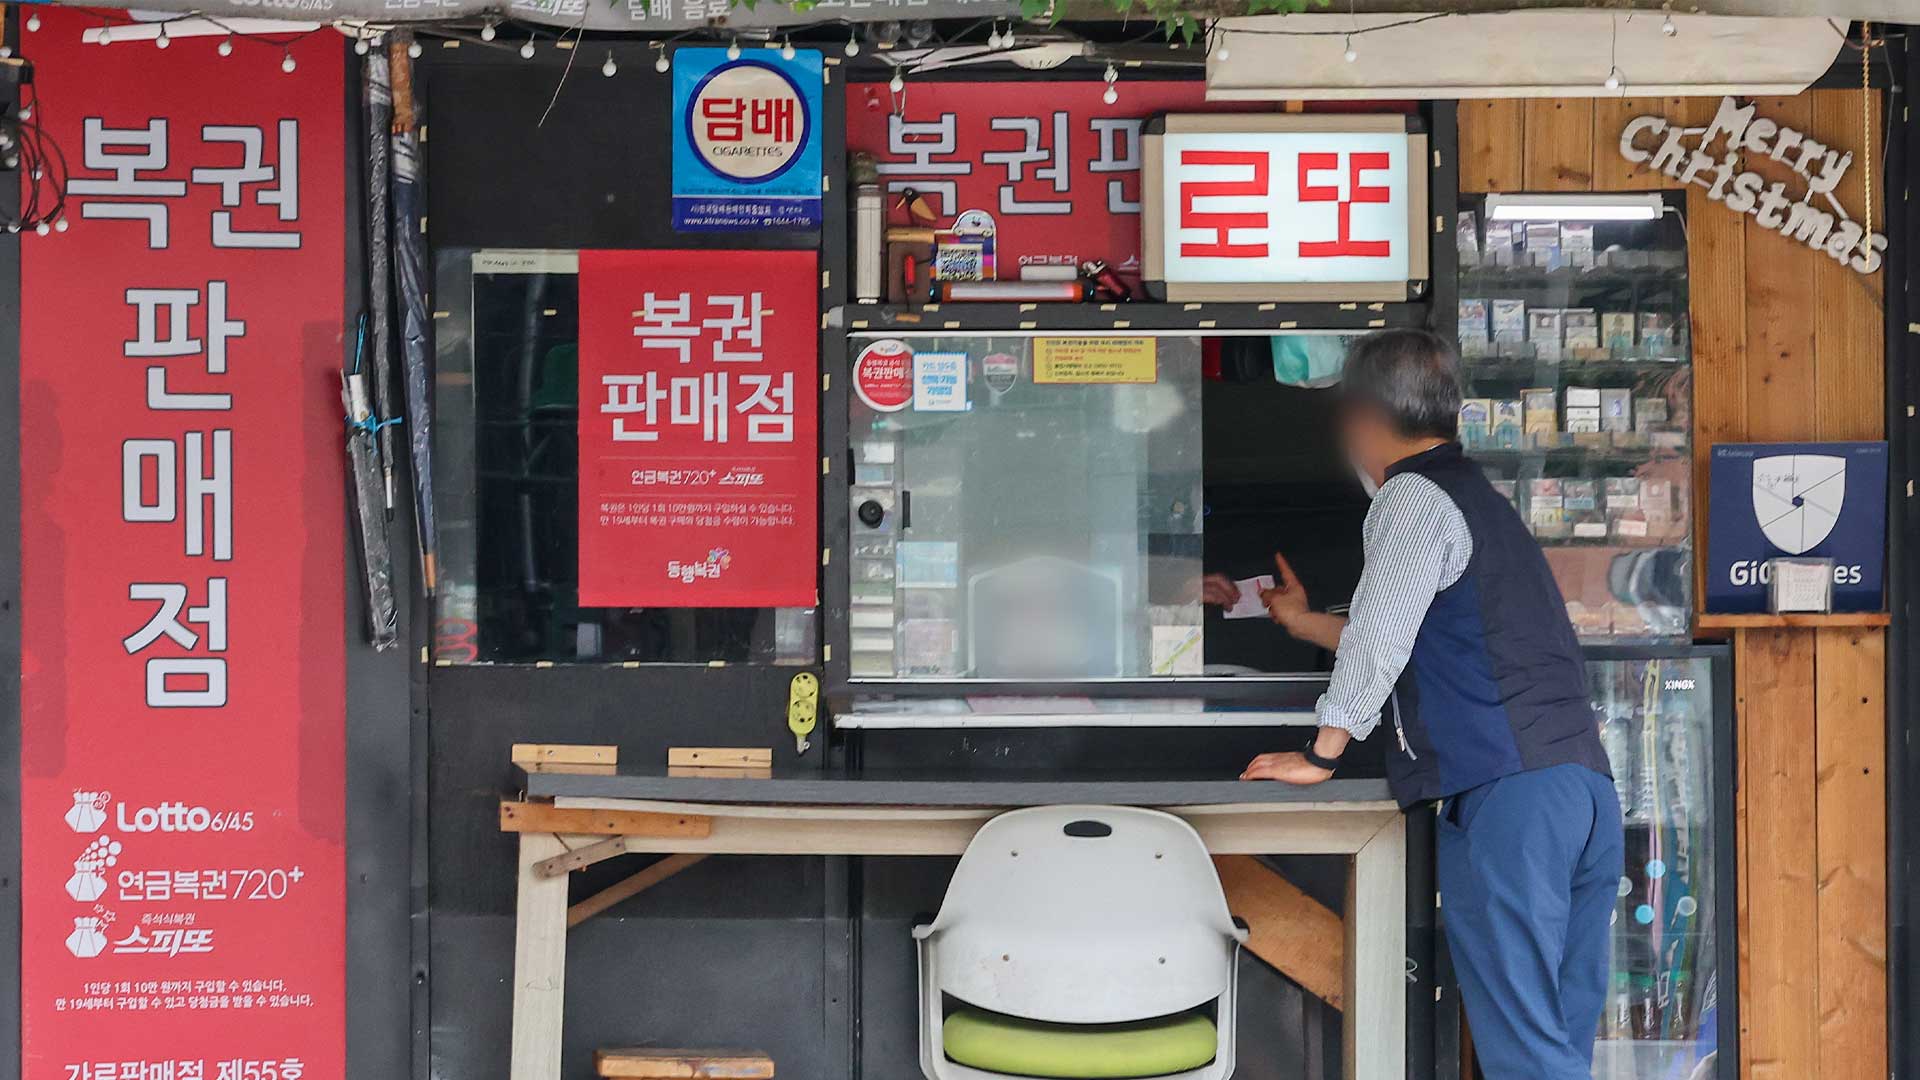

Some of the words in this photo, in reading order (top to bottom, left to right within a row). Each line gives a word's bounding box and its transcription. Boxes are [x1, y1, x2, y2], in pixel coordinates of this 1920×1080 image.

[702, 97, 795, 143] 담배
[712, 145, 784, 158] CIGARETTES
[1699, 96, 1853, 194] Merry
[66, 116, 301, 249] 복권
[1180, 150, 1391, 258] 로또
[1619, 115, 1889, 274] Christmas
[632, 291, 764, 364] 복권
[600, 370, 795, 443] 판매점
[121, 280, 246, 708] 판매점
[112, 924, 215, 959] 스피또
[55, 997, 67, 1011] 만
[70, 997, 114, 1010] 19세부터
[151, 996, 162, 1009] 수
[164, 996, 186, 1009] 있고
[256, 995, 267, 1007] 수
[84, 981, 112, 995] 1인당
[115, 981, 131, 994] 1회
[134, 981, 159, 994] 10만
[228, 980, 239, 993] 수
